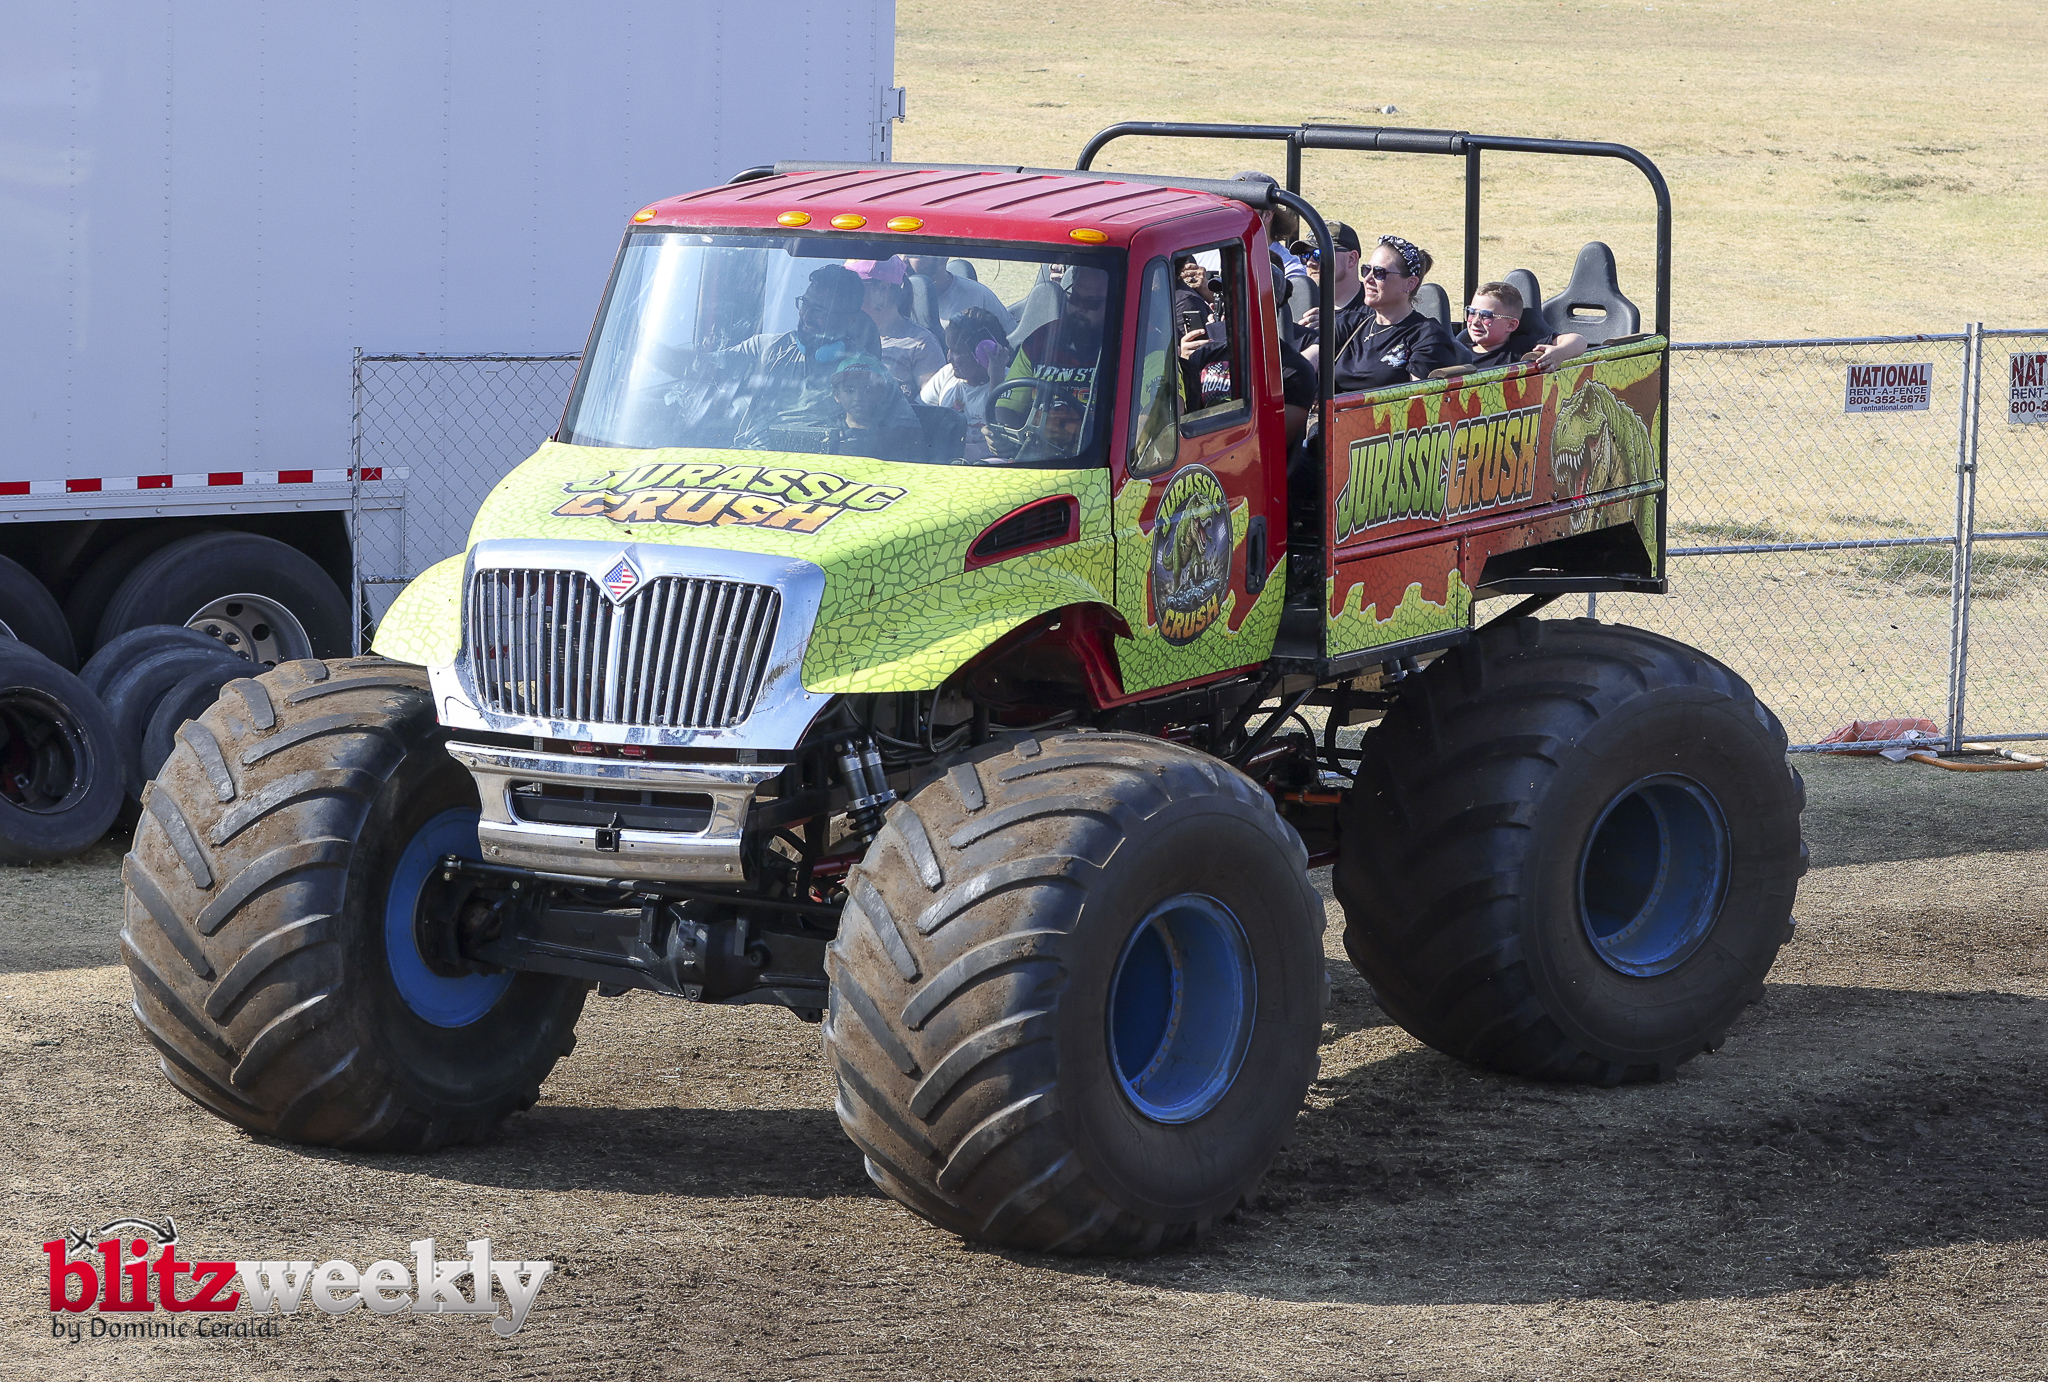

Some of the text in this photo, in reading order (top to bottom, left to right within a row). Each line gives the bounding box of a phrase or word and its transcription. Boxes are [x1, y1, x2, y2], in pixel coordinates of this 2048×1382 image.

[1202, 374, 1231, 393] ROAD
[1849, 387, 1928, 396] RENT-A-FENCE
[1850, 365, 1928, 387] NATIONAL
[1849, 395, 1927, 405] 800-352-5675
[563, 464, 909, 511] JURASSIC
[1336, 406, 1542, 543] JURASSIC CRUSH
[551, 490, 844, 534] CRUSH
[1157, 473, 1223, 538] JURASSIC
[1161, 595, 1220, 639] CRUSH
